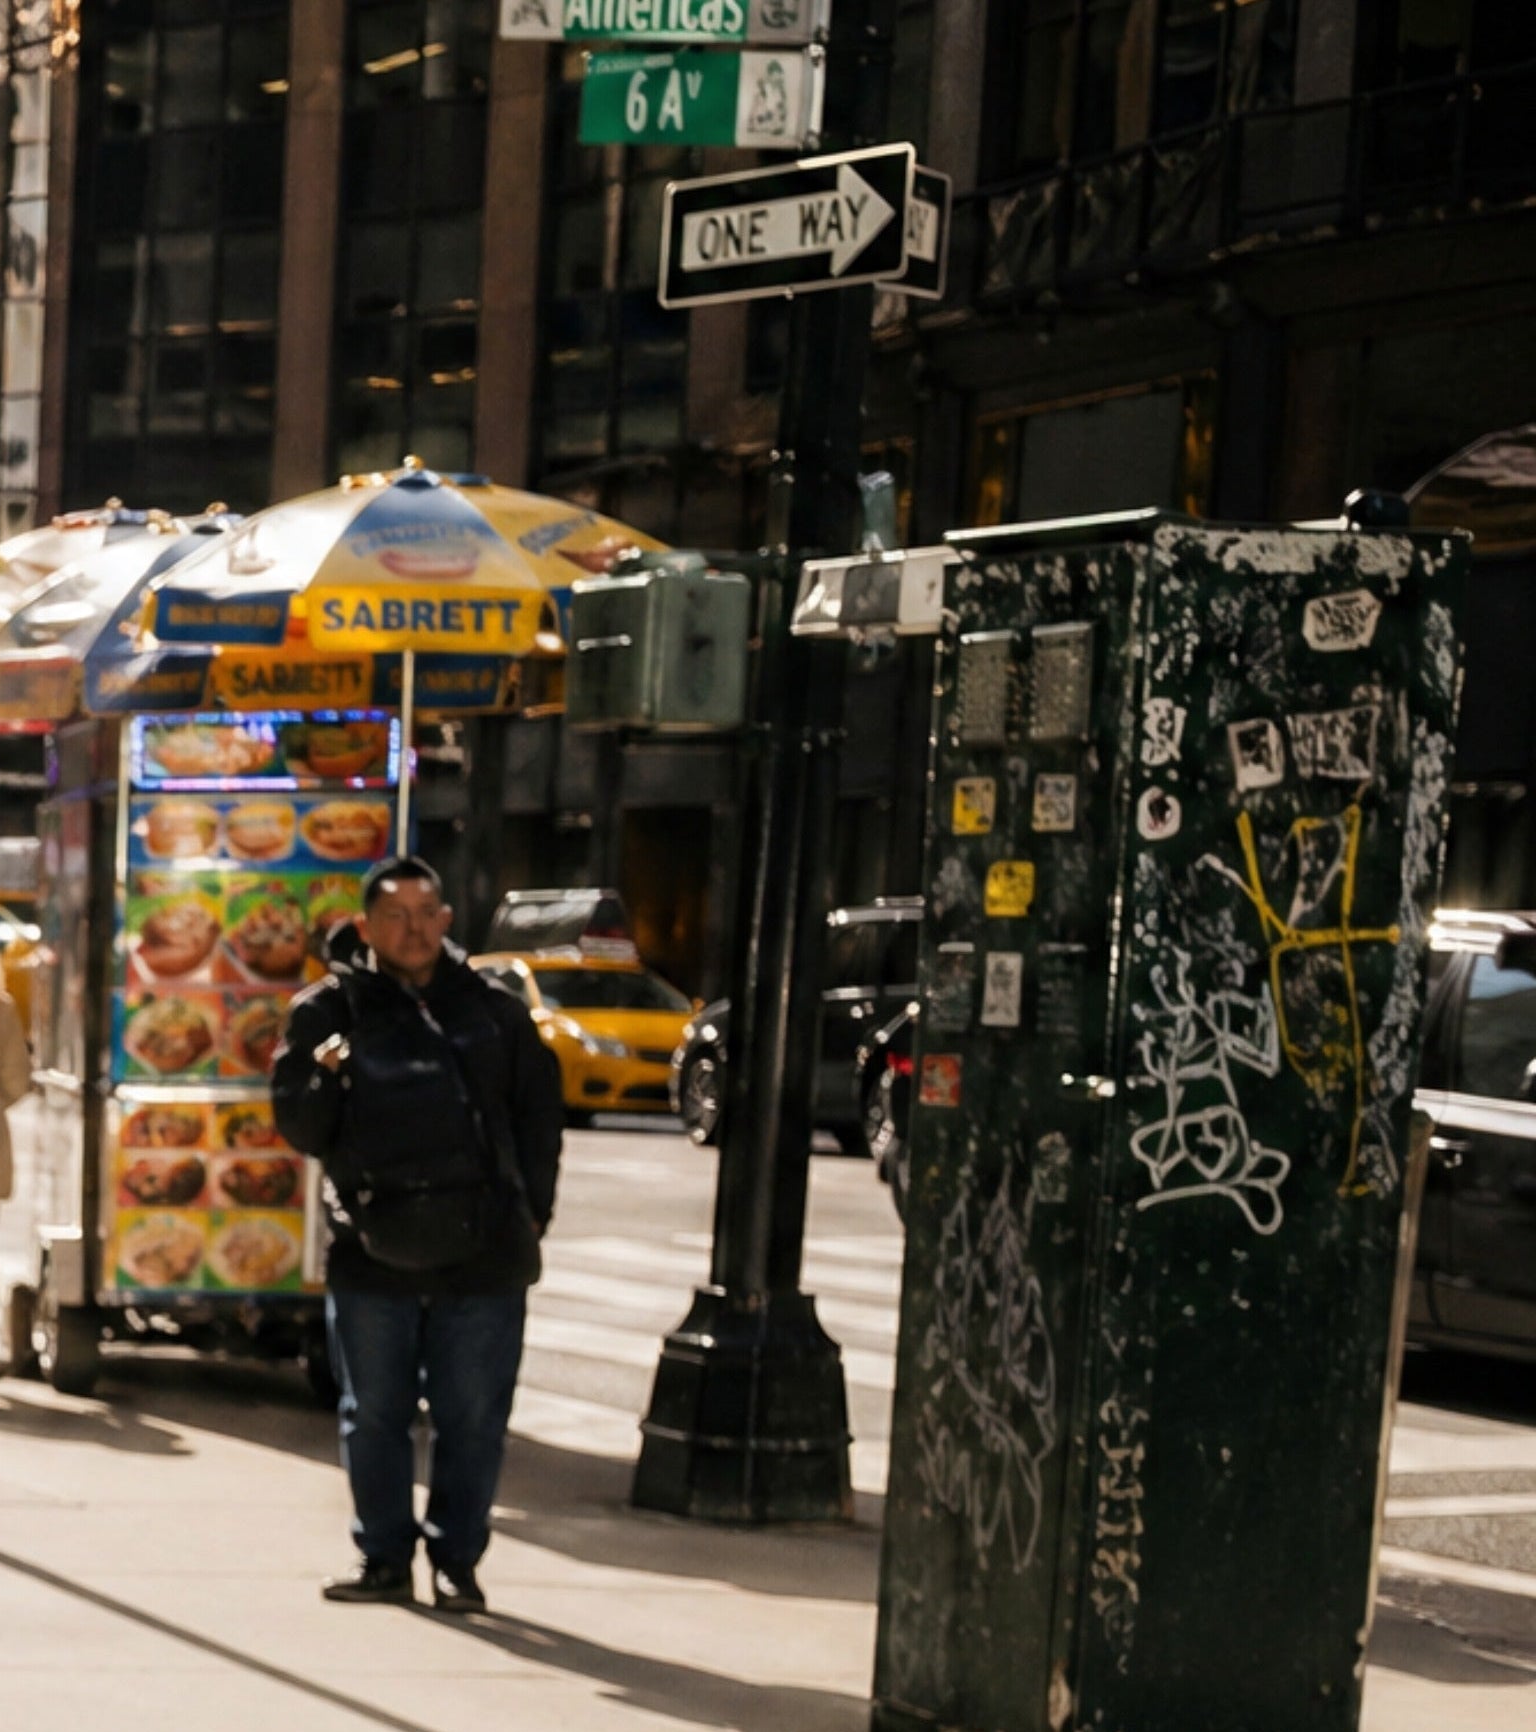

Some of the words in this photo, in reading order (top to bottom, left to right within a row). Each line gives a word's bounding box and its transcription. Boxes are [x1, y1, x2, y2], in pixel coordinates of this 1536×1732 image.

[626, 70, 648, 133] 6
[697, 210, 768, 262] ONE
[799, 195, 867, 246] WAY
[322, 599, 521, 633] SABRETT
